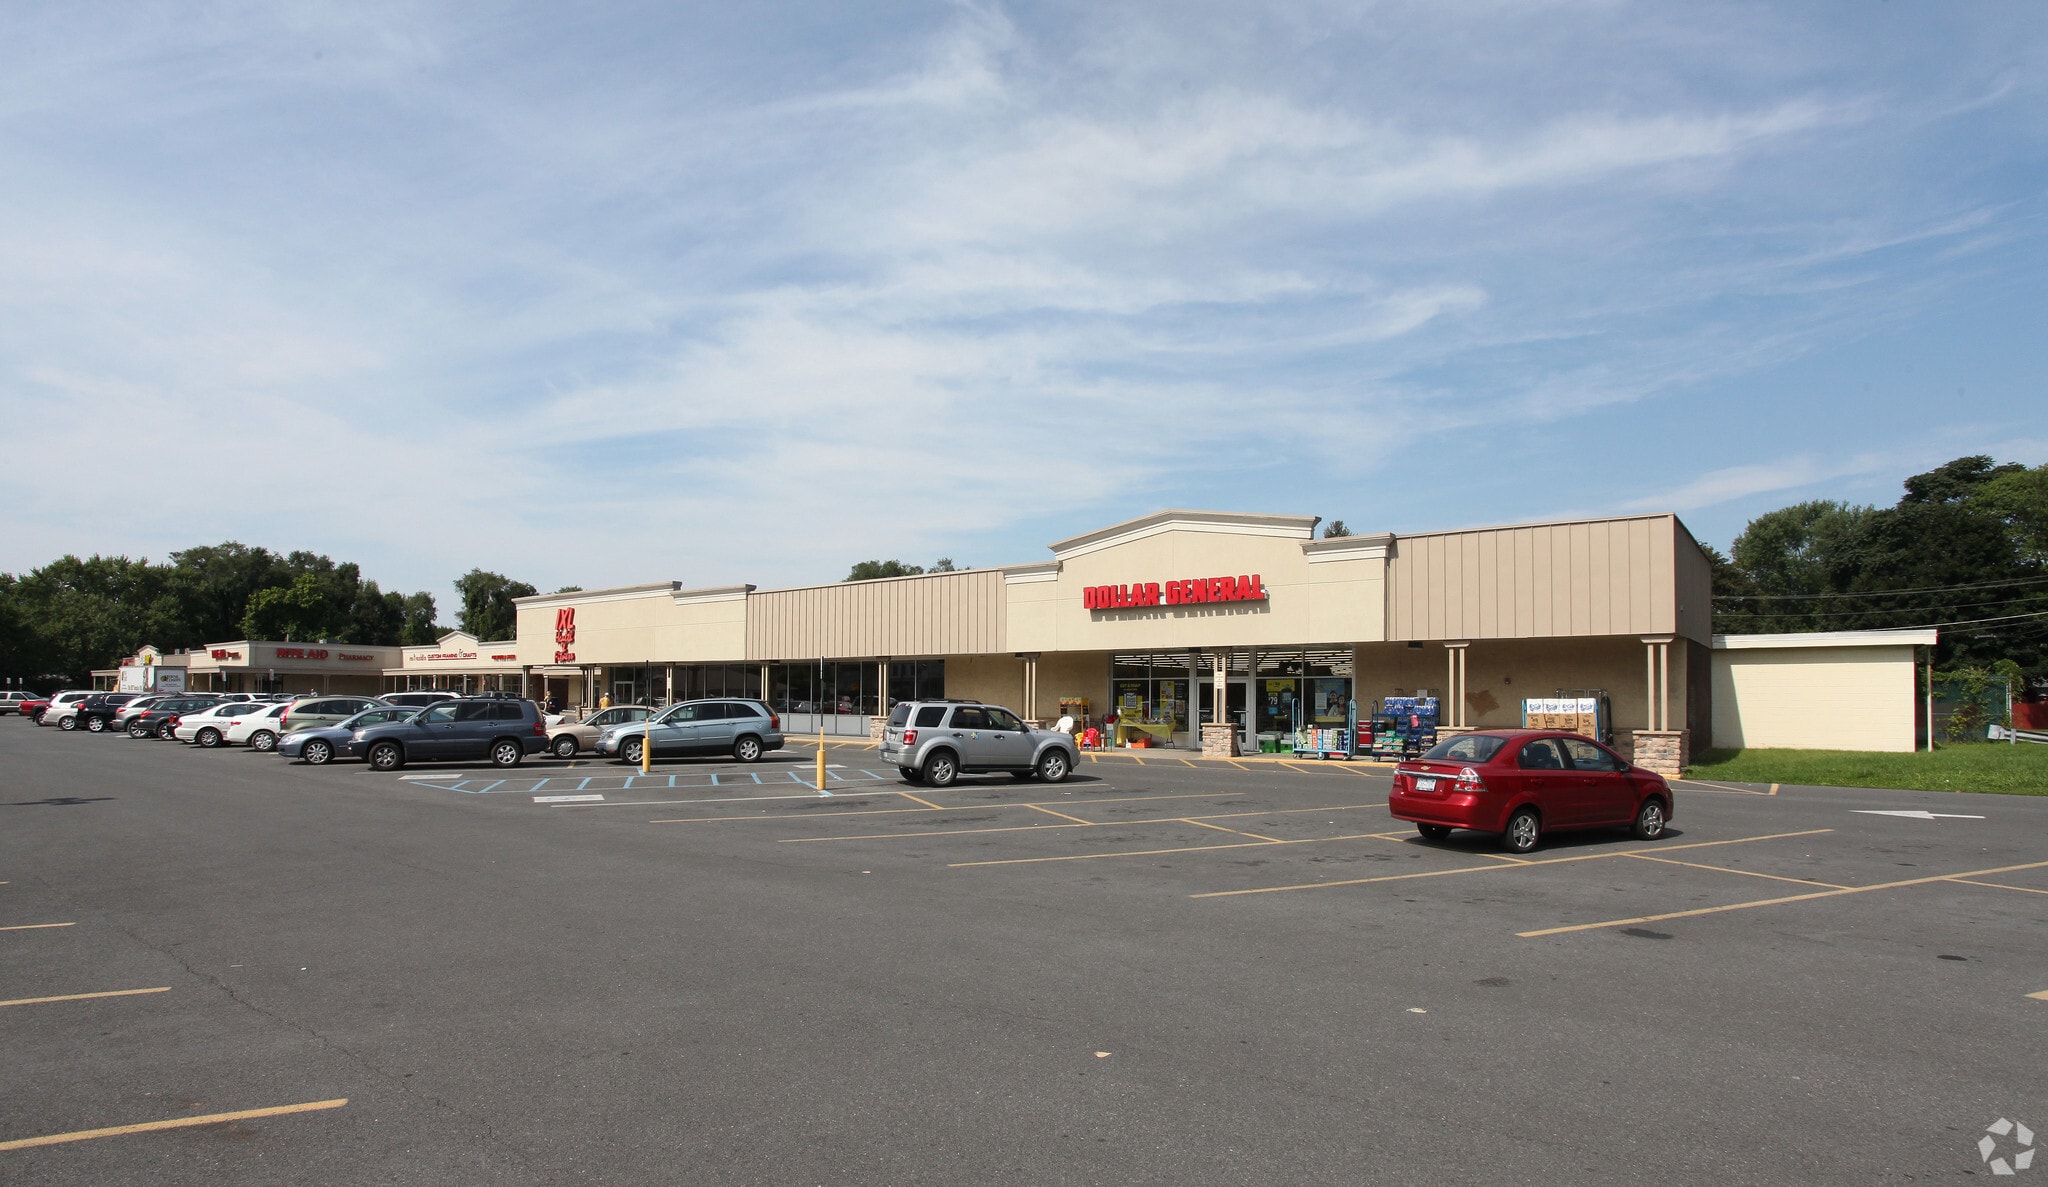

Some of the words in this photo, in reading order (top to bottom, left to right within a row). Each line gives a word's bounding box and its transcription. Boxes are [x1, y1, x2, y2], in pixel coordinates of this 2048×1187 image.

[1083, 582, 1160, 609] DOLLAR
[1165, 574, 1265, 604] GENERAL
[556, 607, 575, 630] IXL
[276, 647, 304, 659] RITE
[305, 649, 329, 660] AID
[338, 653, 374, 661] PHARMACY
